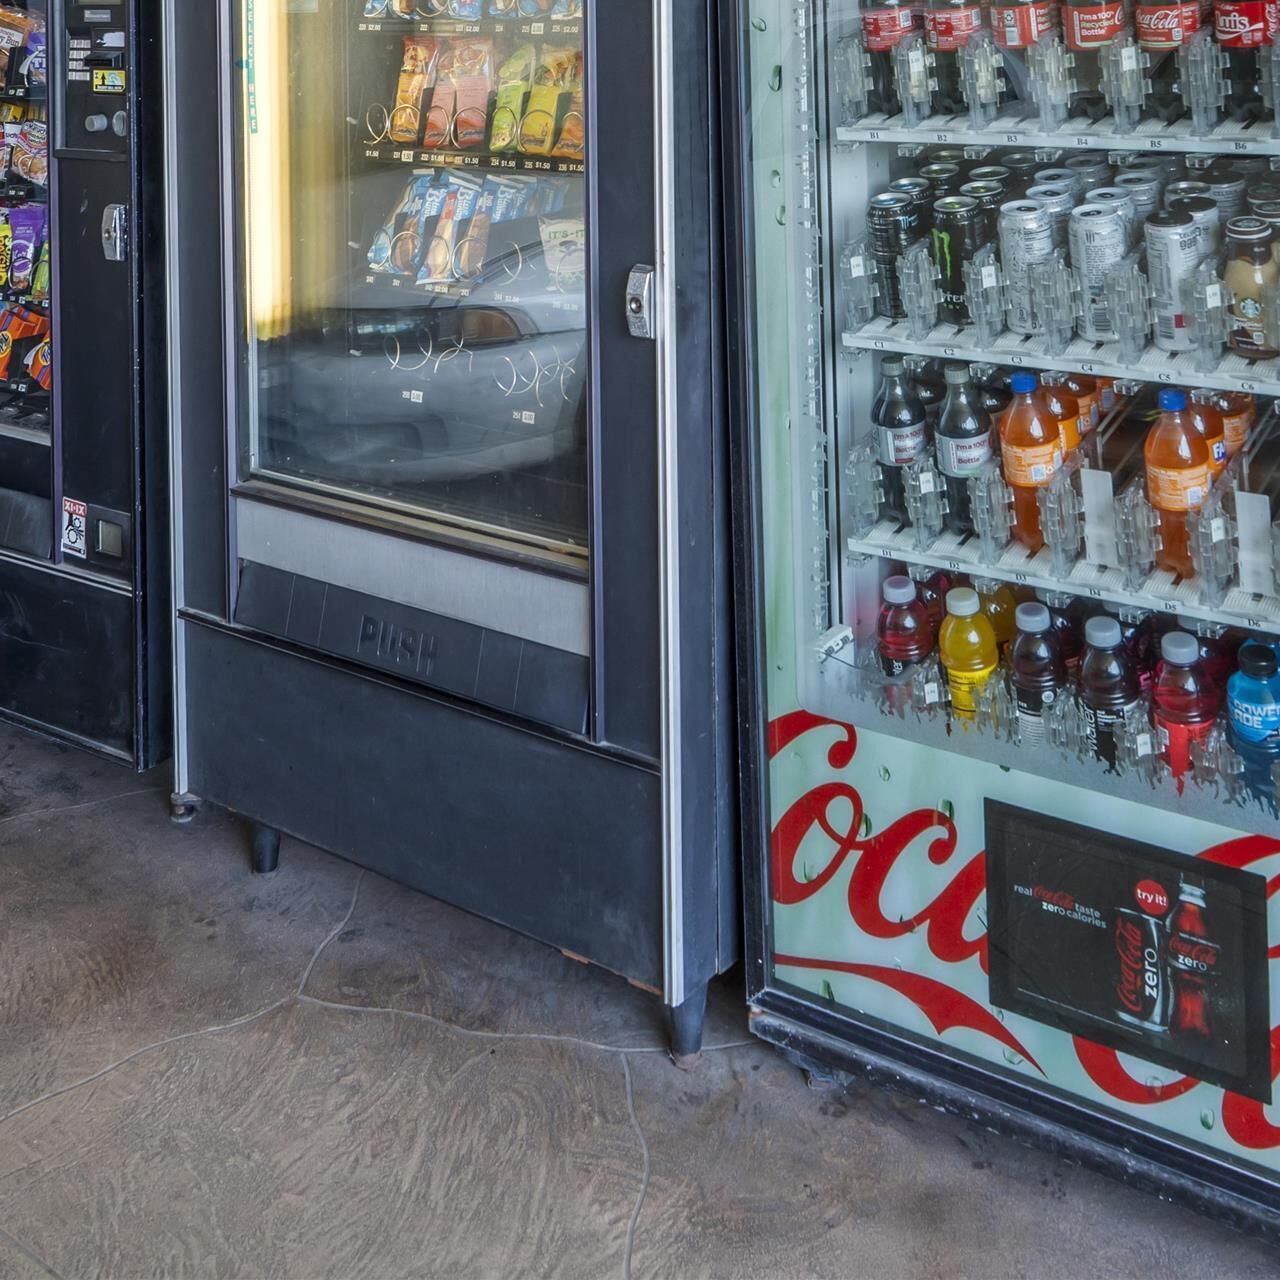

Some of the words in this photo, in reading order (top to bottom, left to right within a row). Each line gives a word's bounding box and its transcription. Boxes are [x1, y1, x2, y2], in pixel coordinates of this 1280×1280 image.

[1080, 20, 1114, 30] Recycled
[1216, 12, 1249, 31] Luis
[870, 131, 879, 139] B1
[937, 134, 947, 142] B2
[1150, 140, 1161, 148] B5
[1235, 142, 1247, 150] B6
[501, 160, 516, 168] $1.50
[535, 161, 551, 170] $1.50
[874, 340, 884, 349] C1
[944, 348, 955, 356] C2
[1012, 356, 1023, 364] C3
[1082, 364, 1093, 372] C4
[1158, 373, 1170, 381] C5
[1242, 382, 1254, 391] C6
[882, 549, 892, 557] D1
[949, 561, 960, 570] D2
[1016, 574, 1026, 582] D3
[1090, 588, 1102, 597] D4
[1165, 602, 1177, 611] D5
[1248, 619, 1260, 628] D6
[356, 614, 436, 676] PUSH
[1014, 883, 1033, 897] real
[1074, 902, 1101, 918] taste
[1136, 888, 1154, 905] try
[1155, 893, 1167, 907] it!
[1042, 900, 1066, 916] zero
[1066, 908, 1108, 929] calories
[1169, 936, 1217, 966] Coca-Cola
[1178, 954, 1208, 972] zero
[1116, 919, 1142, 1013] Coca-Cola
[1144, 948, 1158, 1000] zero
